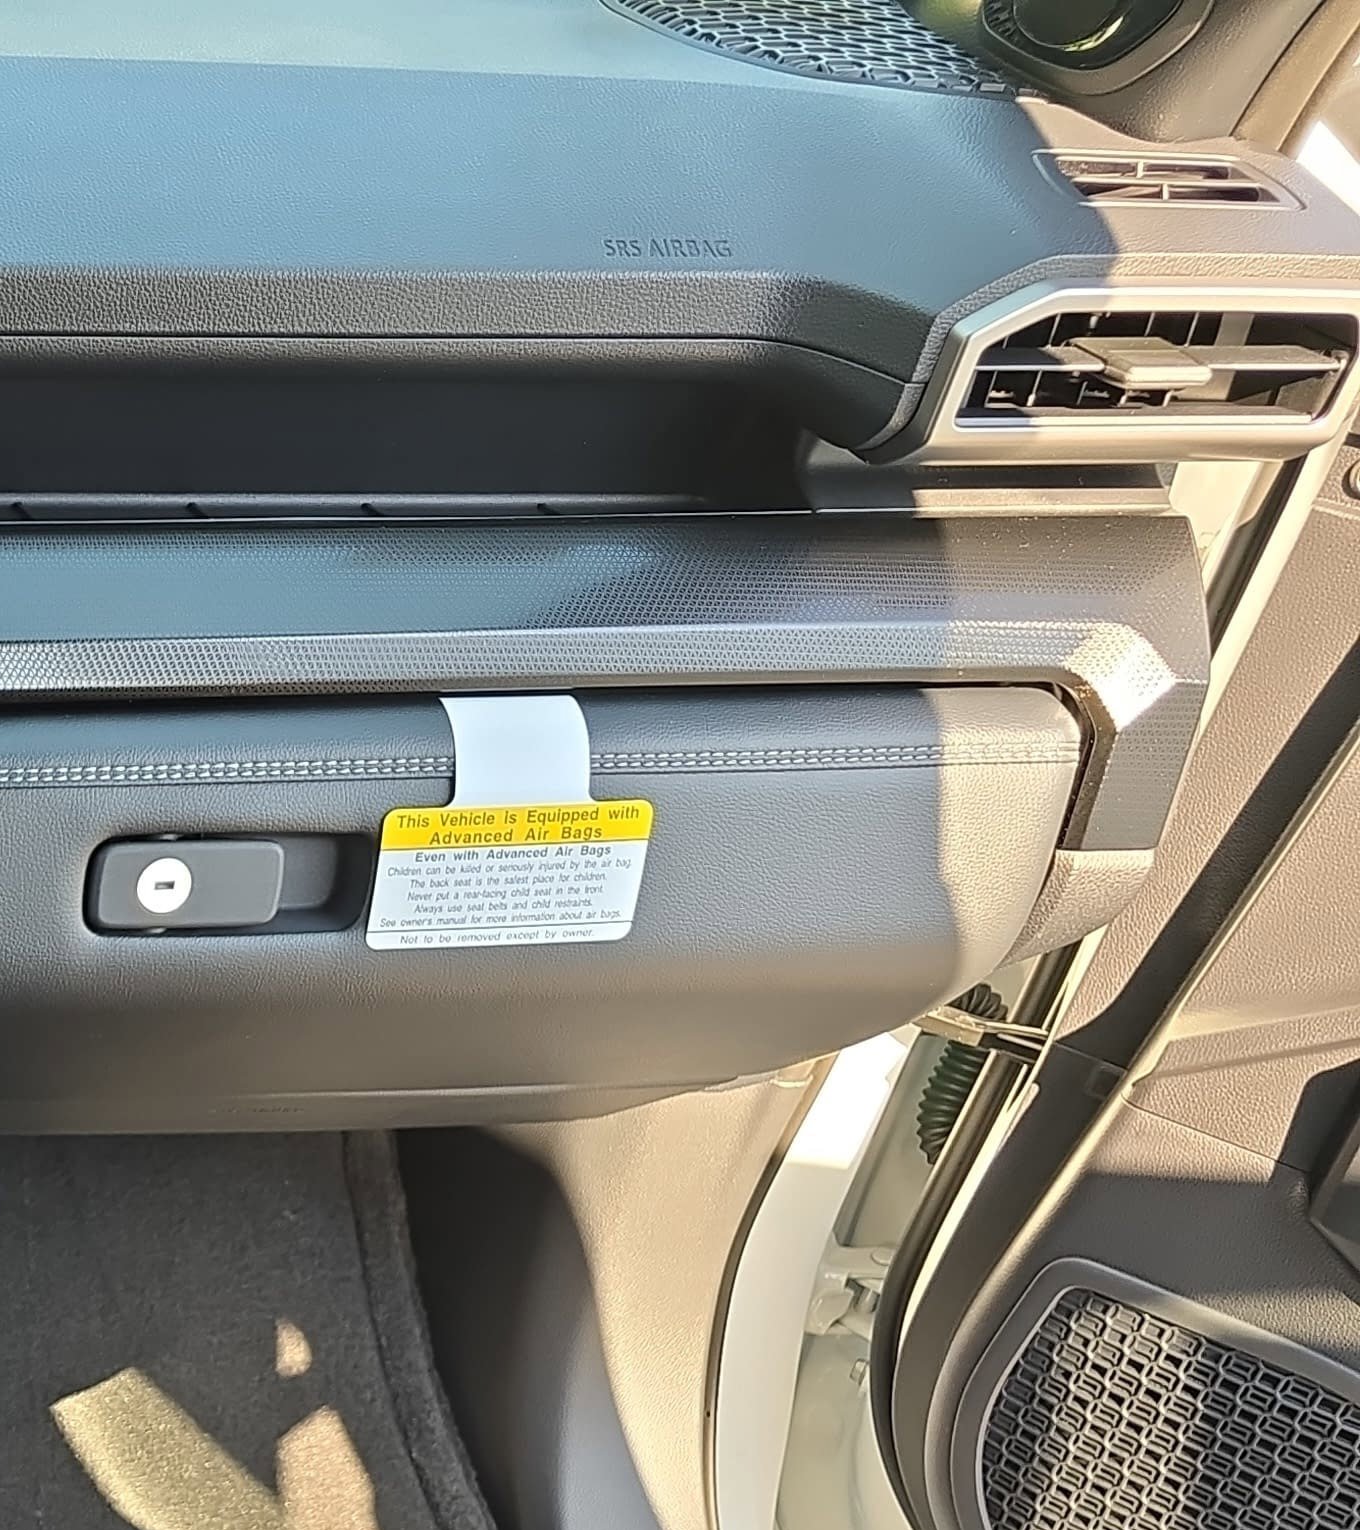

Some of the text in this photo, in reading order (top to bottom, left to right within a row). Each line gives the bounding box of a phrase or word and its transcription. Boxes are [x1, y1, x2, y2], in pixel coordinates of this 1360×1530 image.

[603, 239, 732, 258] SRS AIRBAG
[397, 806, 640, 828] This Vehicle is Equipped with
[430, 826, 602, 845] Advanced Air Bags
[415, 845, 611, 862] Even with Advanced Air Bags
[388, 866, 421, 877] Children
[425, 867, 441, 875] can
[445, 865, 456, 875] be
[485, 864, 494, 873] or
[538, 861, 565, 872] injured
[570, 860, 580, 871] by
[584, 859, 597, 869] the
[410, 879, 425, 888] The
[430, 878, 449, 888] back
[453, 878, 471, 887] seat
[486, 876, 500, 885] the
[532, 874, 554, 886] place
[407, 891, 432, 901] Never
[435, 891, 449, 902] put
[463, 889, 507, 900] rear-facing
[510, 888, 530, 898] child
[534, 887, 552, 896] seat
[567, 885, 580, 894] the
[414, 903, 442, 914] Always
[447, 904, 462, 912] use
[467, 902, 484, 912] seat
[532, 899, 550, 909] child
[380, 918, 396, 927] See
[436, 916, 467, 925] manual
[471, 914, 481, 924] for
[486, 914, 507, 923] more
[511, 912, 555, 922] information
[559, 911, 582, 920] about
[400, 935, 418, 945] Not
[424, 935, 433, 944] to
[439, 934, 451, 943] be
[457, 932, 500, 942] removed
[506, 930, 539, 941] except
[545, 930, 557, 939] by
